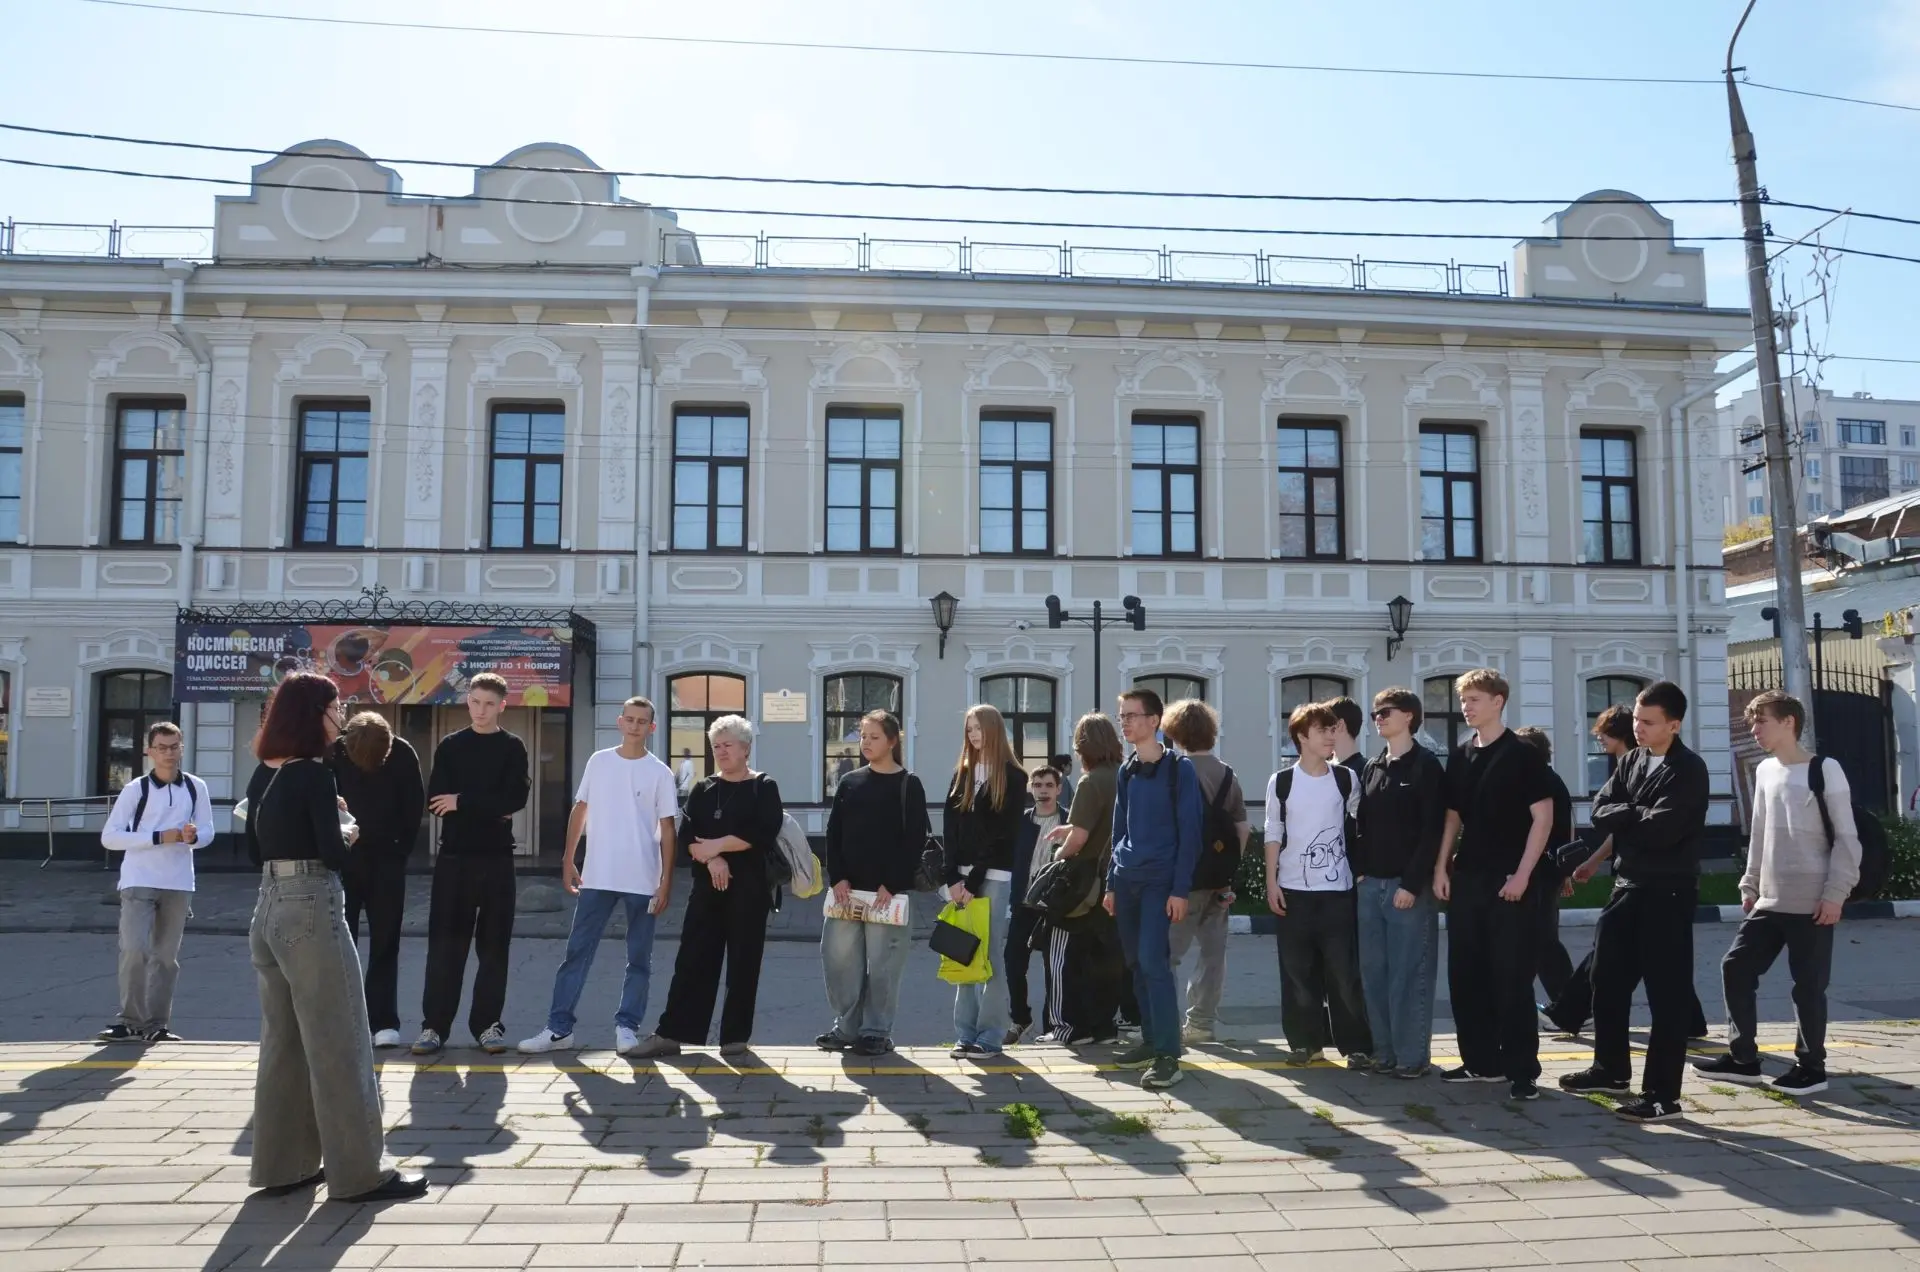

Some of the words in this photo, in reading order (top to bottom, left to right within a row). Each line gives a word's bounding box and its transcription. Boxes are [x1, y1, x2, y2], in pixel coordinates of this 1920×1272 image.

[187, 636, 284, 652] КОСМИЧЕСКАЯ
[186, 655, 247, 671] ОДИССЕЯ
[524, 662, 560, 670] НОЯБРЯ
